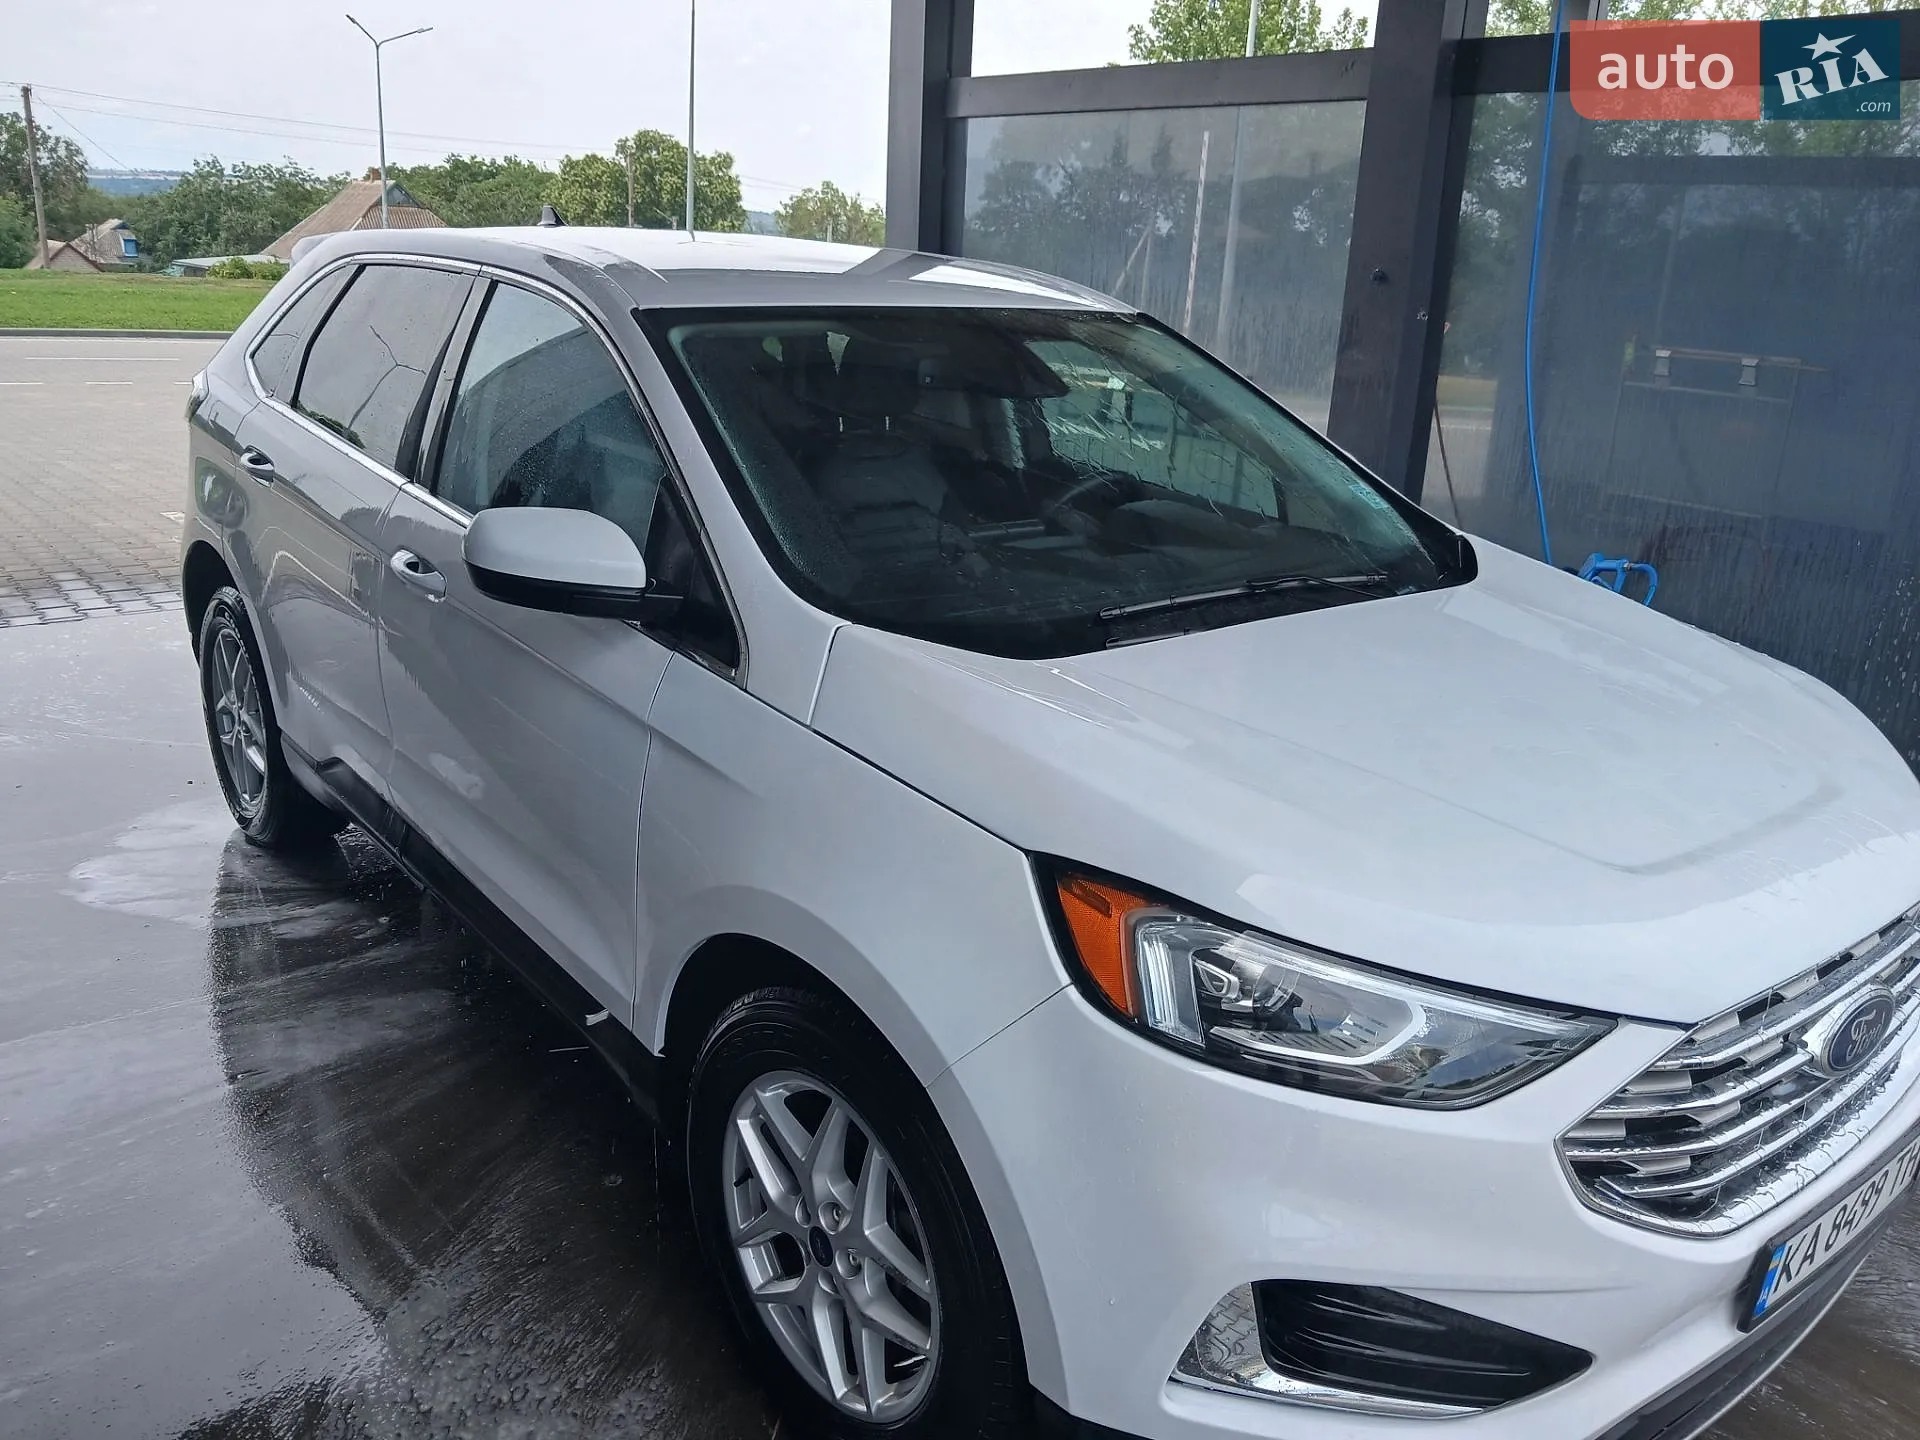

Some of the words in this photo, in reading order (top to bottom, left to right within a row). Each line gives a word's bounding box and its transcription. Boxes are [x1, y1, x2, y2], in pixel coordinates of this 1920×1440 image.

[1846, 1009, 1886, 1062] Ford
[1773, 1222, 1822, 1294] KA
[1825, 1169, 1890, 1252] 8499
